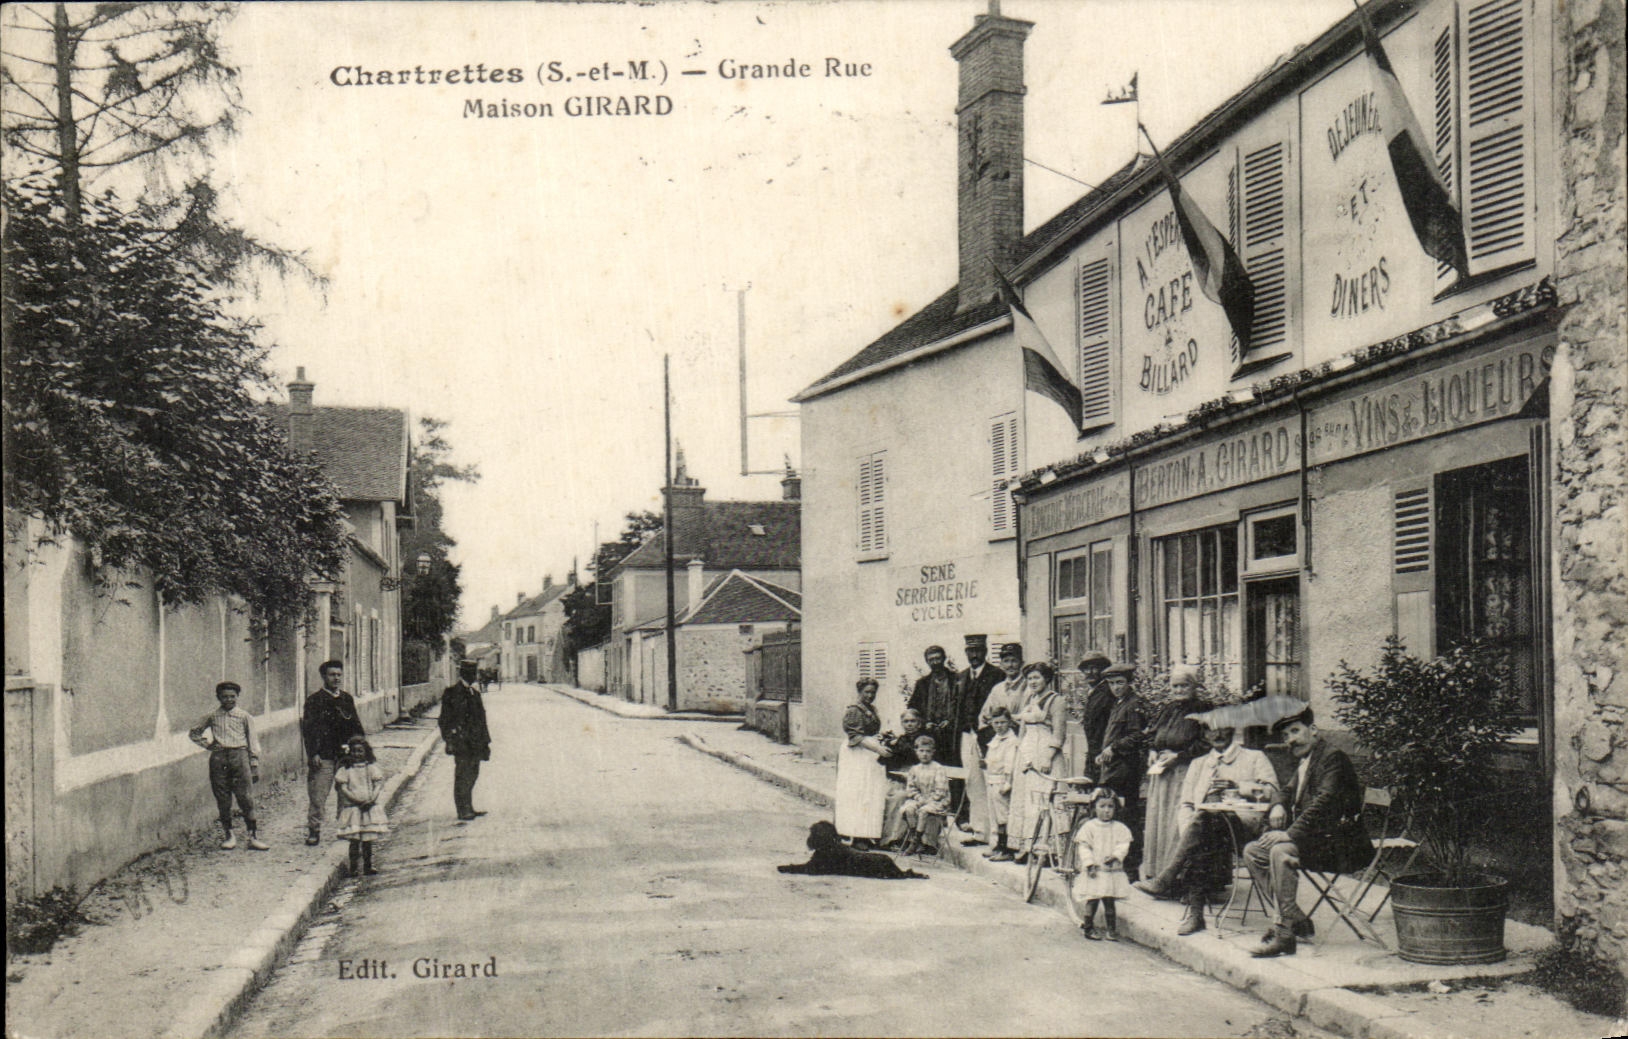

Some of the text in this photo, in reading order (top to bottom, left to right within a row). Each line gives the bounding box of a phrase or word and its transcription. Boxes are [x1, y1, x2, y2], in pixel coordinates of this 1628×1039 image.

[1350, 178, 1369, 221] ET
[1144, 270, 1193, 330] CAFE
[1331, 255, 1391, 316] DINERS
[1139, 337, 1199, 394] BILLARD
[1350, 394, 1401, 448] VINS
[1216, 426, 1290, 482] GIRARD
[895, 580, 979, 607] SERRURERIE
[911, 603, 964, 622] CYCLES
